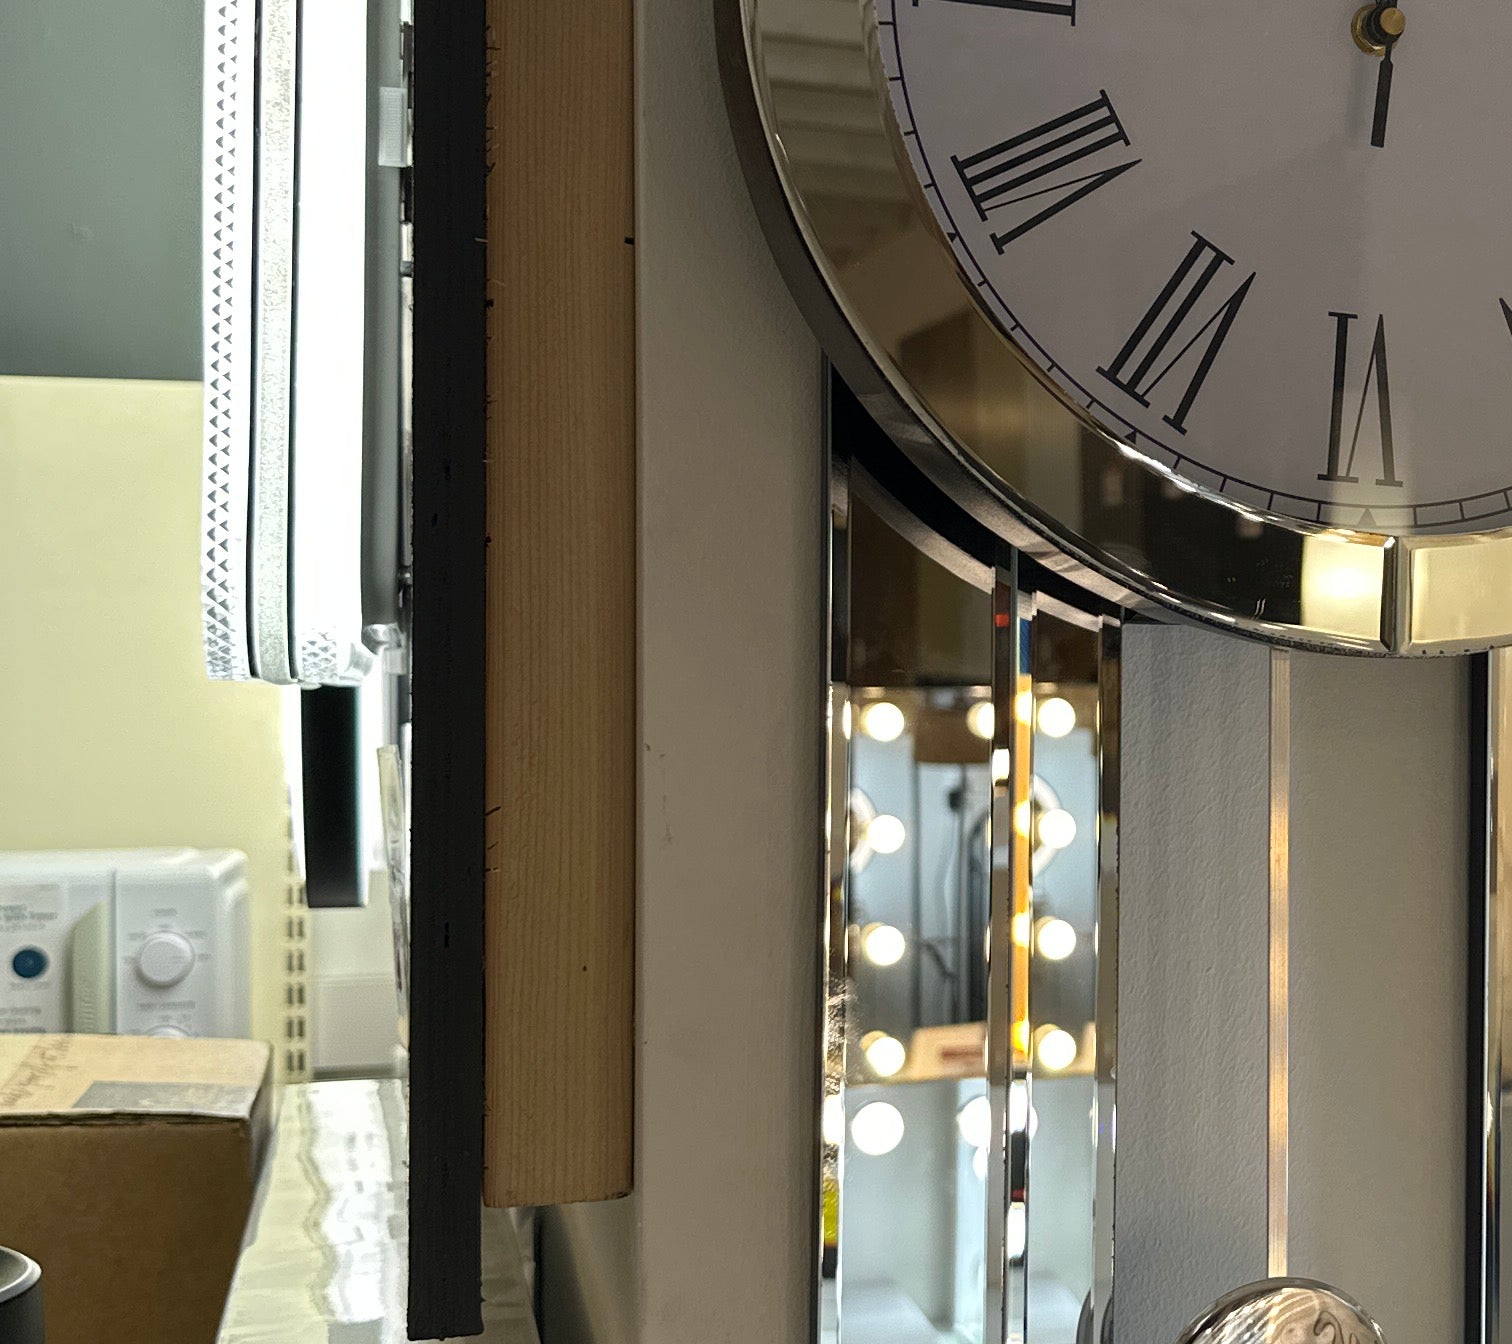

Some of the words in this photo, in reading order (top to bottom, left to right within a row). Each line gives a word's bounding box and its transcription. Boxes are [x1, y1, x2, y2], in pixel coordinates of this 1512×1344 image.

[951, 89, 1142, 254] VIII
[1097, 231, 1256, 434] VII
[1317, 312, 1402, 487] VI
